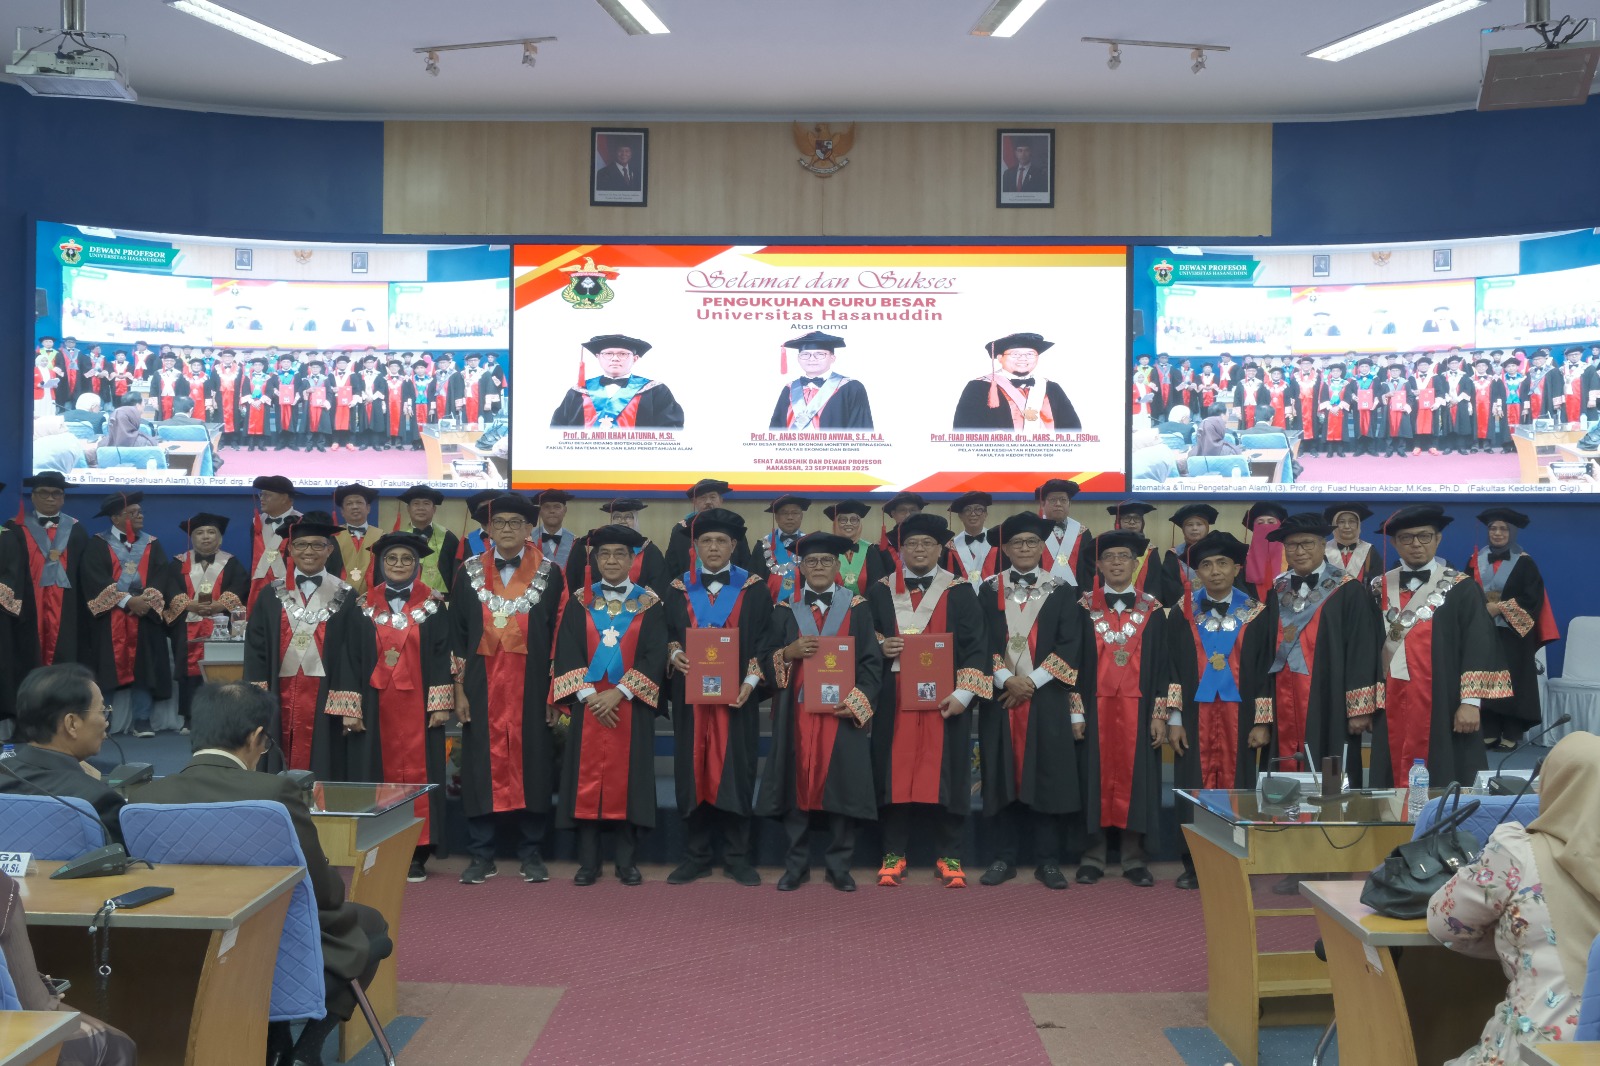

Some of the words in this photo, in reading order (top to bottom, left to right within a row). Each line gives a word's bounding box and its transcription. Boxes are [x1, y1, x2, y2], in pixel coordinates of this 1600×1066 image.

[89, 246, 120, 255] DEWAN
[122, 249, 166, 258] PROFESOR
[686, 270, 800, 290] Selamat
[805, 272, 849, 289] dan
[858, 270, 956, 290] Sukses
[703, 297, 824, 307] PENGUKUHAN
[828, 297, 876, 307] GURU
[881, 297, 936, 307] BESAR
[697, 308, 813, 320] Universitas
[822, 309, 942, 321] Hasanuddin
[109, 476, 163, 485] Pengetahuan
[165, 477, 190, 485] Alam),
[230, 478, 245, 486] drg.
[1198, 484, 1247, 493] Pengetahuan
[1310, 484, 1324, 493] drg.
[1379, 484, 1404, 492] Akbar,
[1406, 484, 1437, 492] M.Kes.,
[1467, 484, 1506, 492] (Fakultas
[1560, 484, 1582, 493] Gigi).
